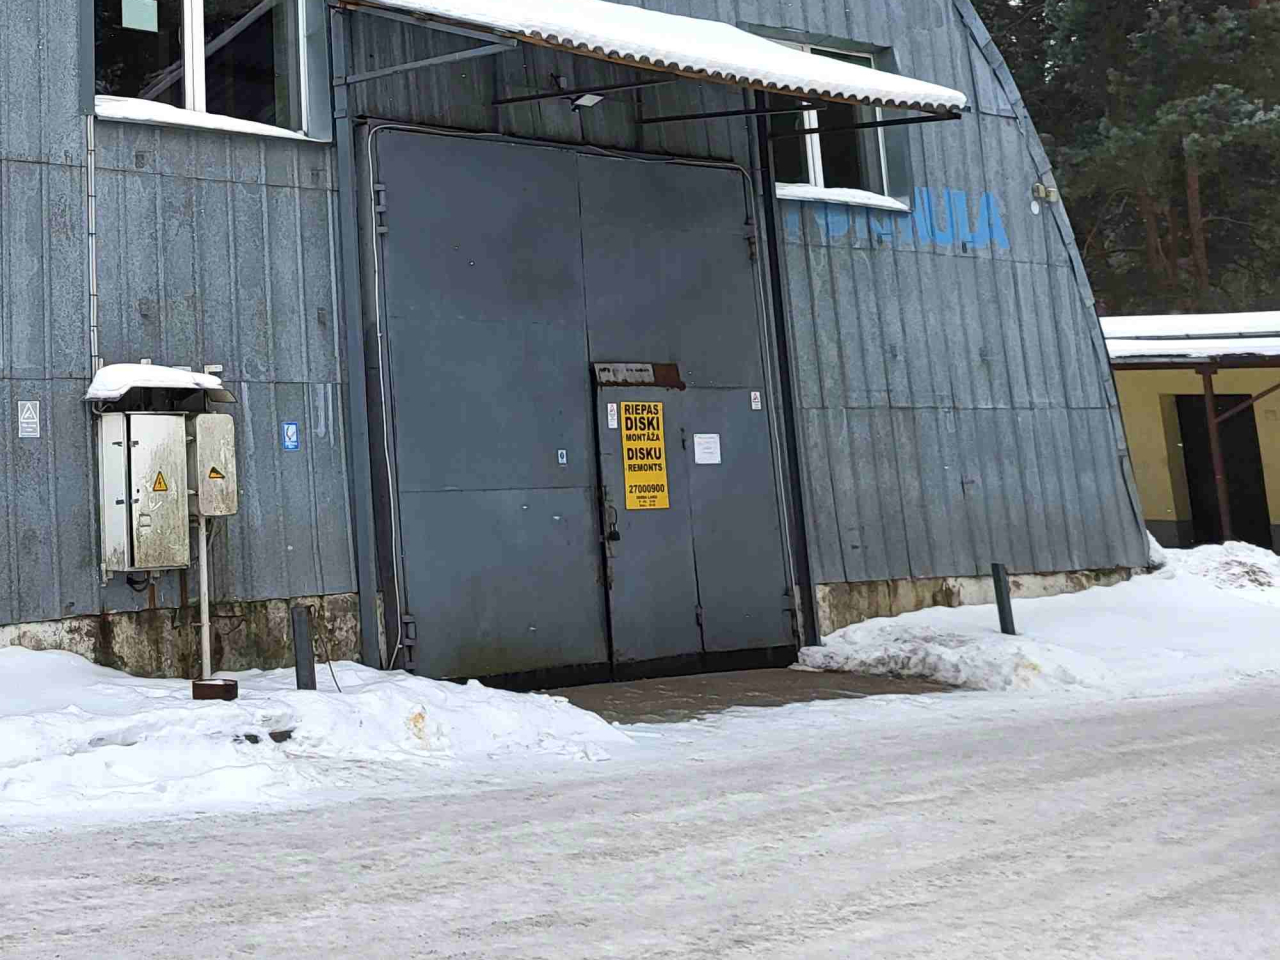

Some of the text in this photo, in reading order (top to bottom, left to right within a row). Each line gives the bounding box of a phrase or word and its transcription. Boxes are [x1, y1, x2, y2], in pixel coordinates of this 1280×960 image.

[624, 403, 659, 416] RIEPAS
[625, 416, 660, 431] DISKI
[625, 431, 661, 442] MONTĀŽA
[627, 447, 662, 461] DISKU
[628, 463, 663, 472] REMONTS
[629, 483, 665, 494] 27000900
